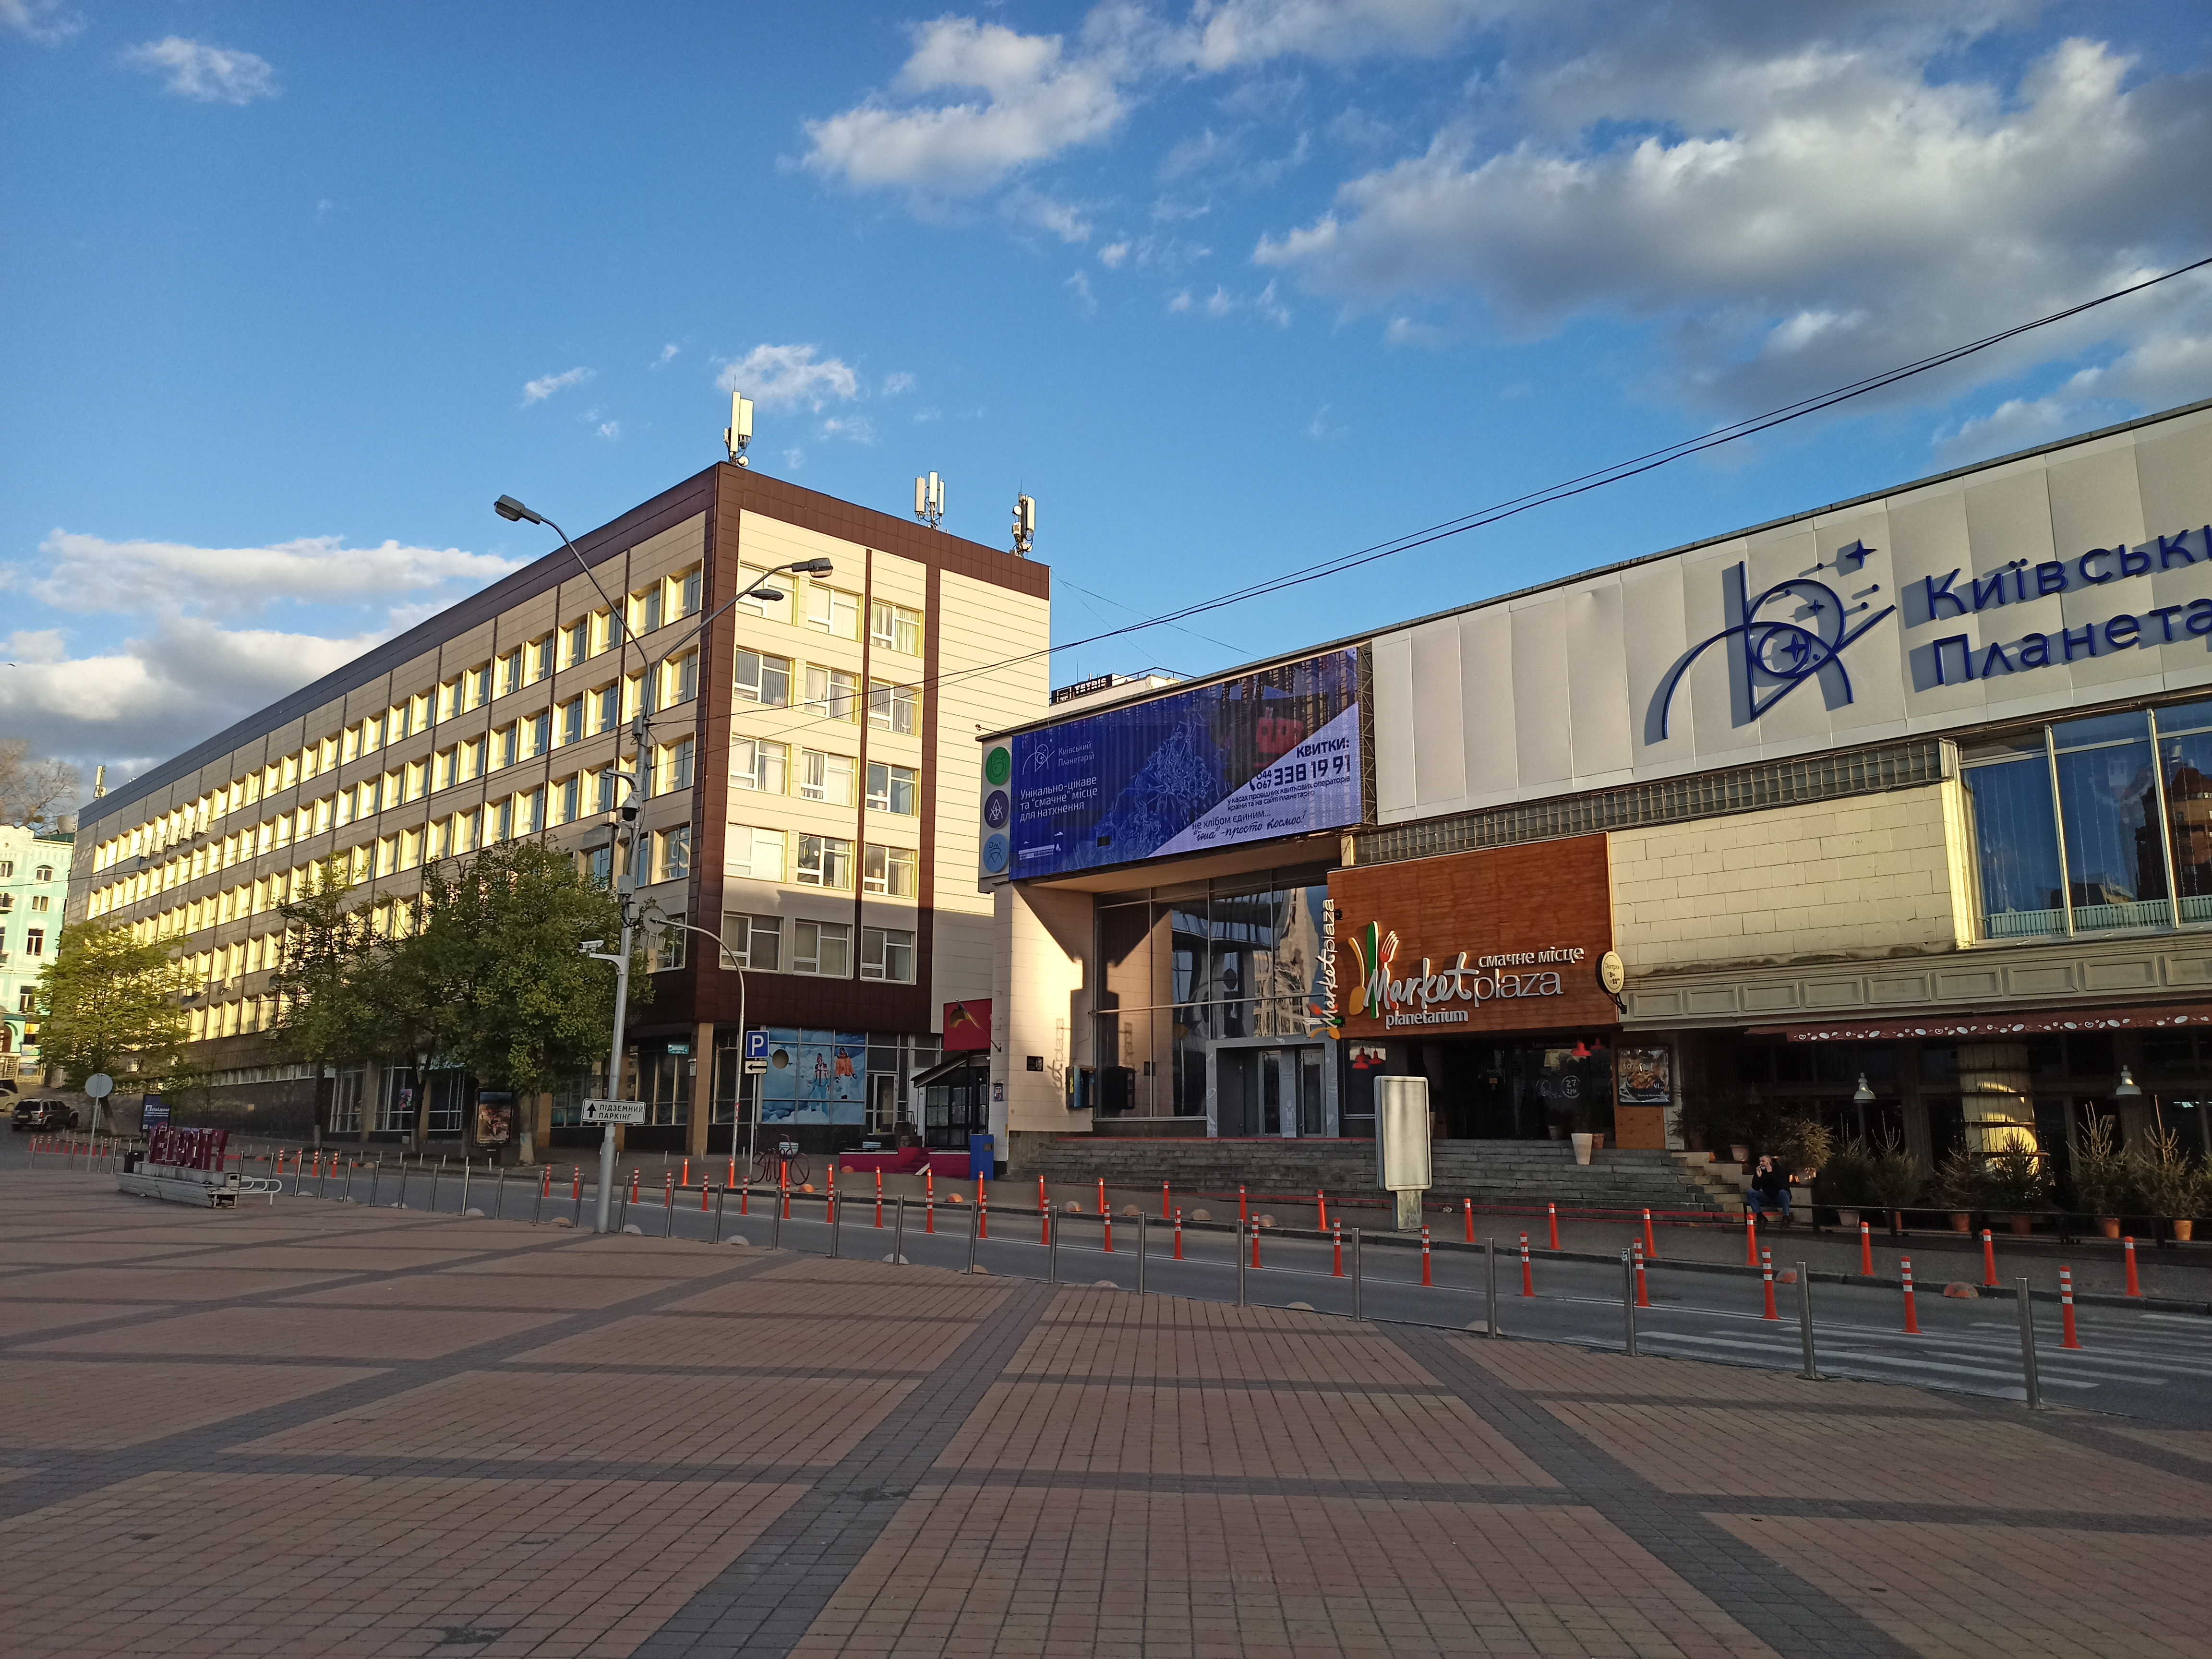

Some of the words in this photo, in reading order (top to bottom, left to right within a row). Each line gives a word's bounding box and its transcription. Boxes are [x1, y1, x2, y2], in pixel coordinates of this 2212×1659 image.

[1058, 741, 1092, 756] Київський
[1297, 737, 1349, 758] КВИТКИ:
[1058, 752, 1094, 767] Планетарій
[1256, 770, 1272, 780] 044
[1274, 763, 1306, 786] 338
[1311, 759, 1328, 778] 19
[1021, 776, 1097, 800] Унікально-цікаве
[1256, 780, 1272, 790] 067
[1020, 802, 1030, 811] та
[1072, 787, 1097, 800] місце
[1020, 811, 1035, 823] для
[1037, 802, 1084, 818] натхнення
[1203, 817, 1231, 828] хлібом
[1322, 898, 1338, 953] plaza
[1478, 952, 1535, 968] смачне
[1538, 946, 1585, 964] місце
[1315, 949, 1338, 1028] Market
[1363, 951, 1479, 1010] Market
[1474, 968, 1563, 1008] plaza
[1385, 1008, 1468, 1030] planetarium
[752, 1035, 764, 1056] P
[600, 1105, 643, 1113] ПІДЗЕМНИЙ
